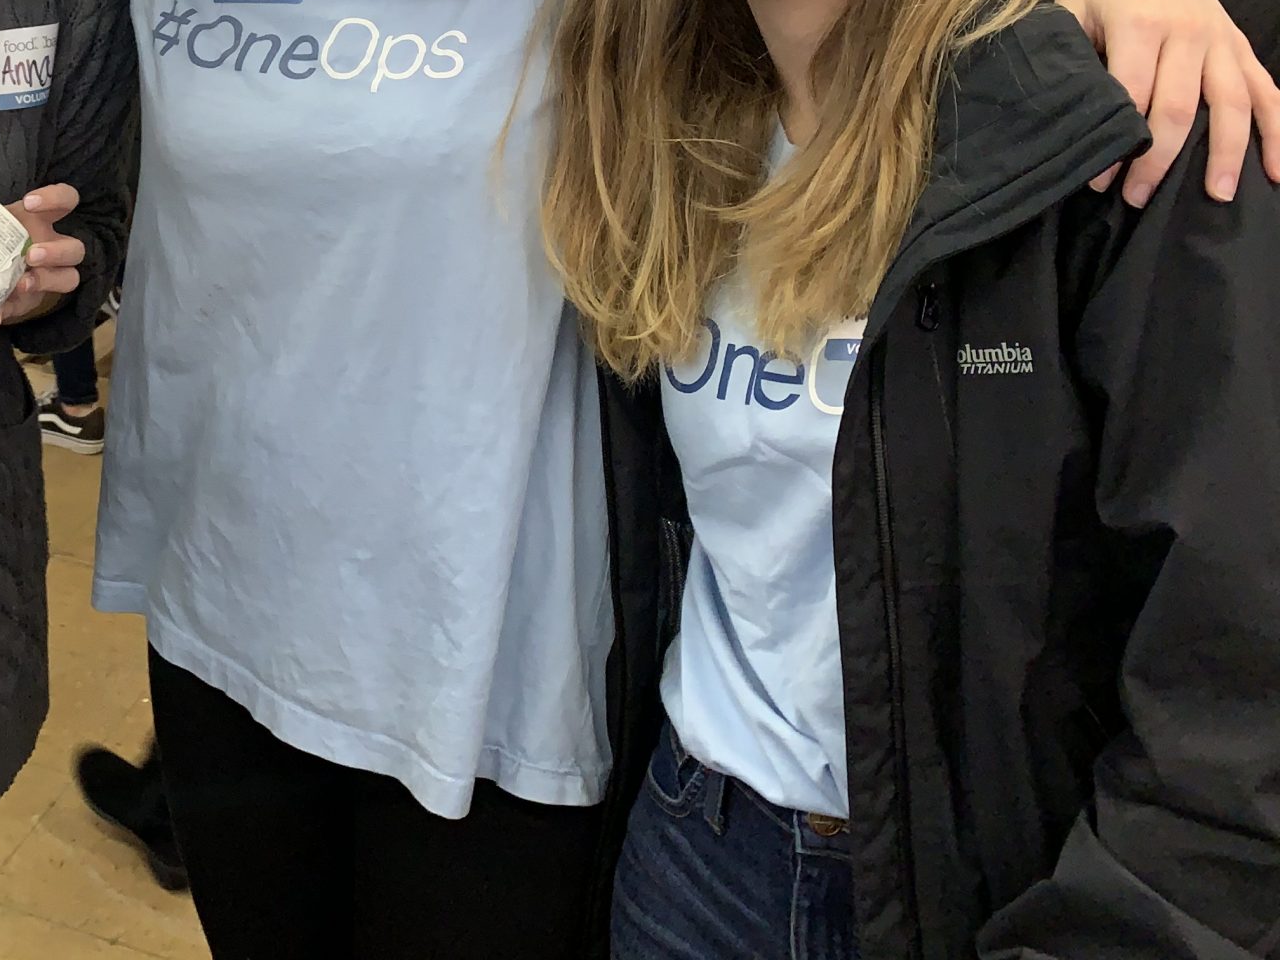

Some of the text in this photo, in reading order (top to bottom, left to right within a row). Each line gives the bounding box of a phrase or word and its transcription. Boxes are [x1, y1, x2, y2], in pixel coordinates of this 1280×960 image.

[4, 38, 35, 53] food
[153, 0, 468, 93] #OneOps
[957, 342, 1033, 363] olumbia
[960, 362, 1034, 375] TITANIUM
